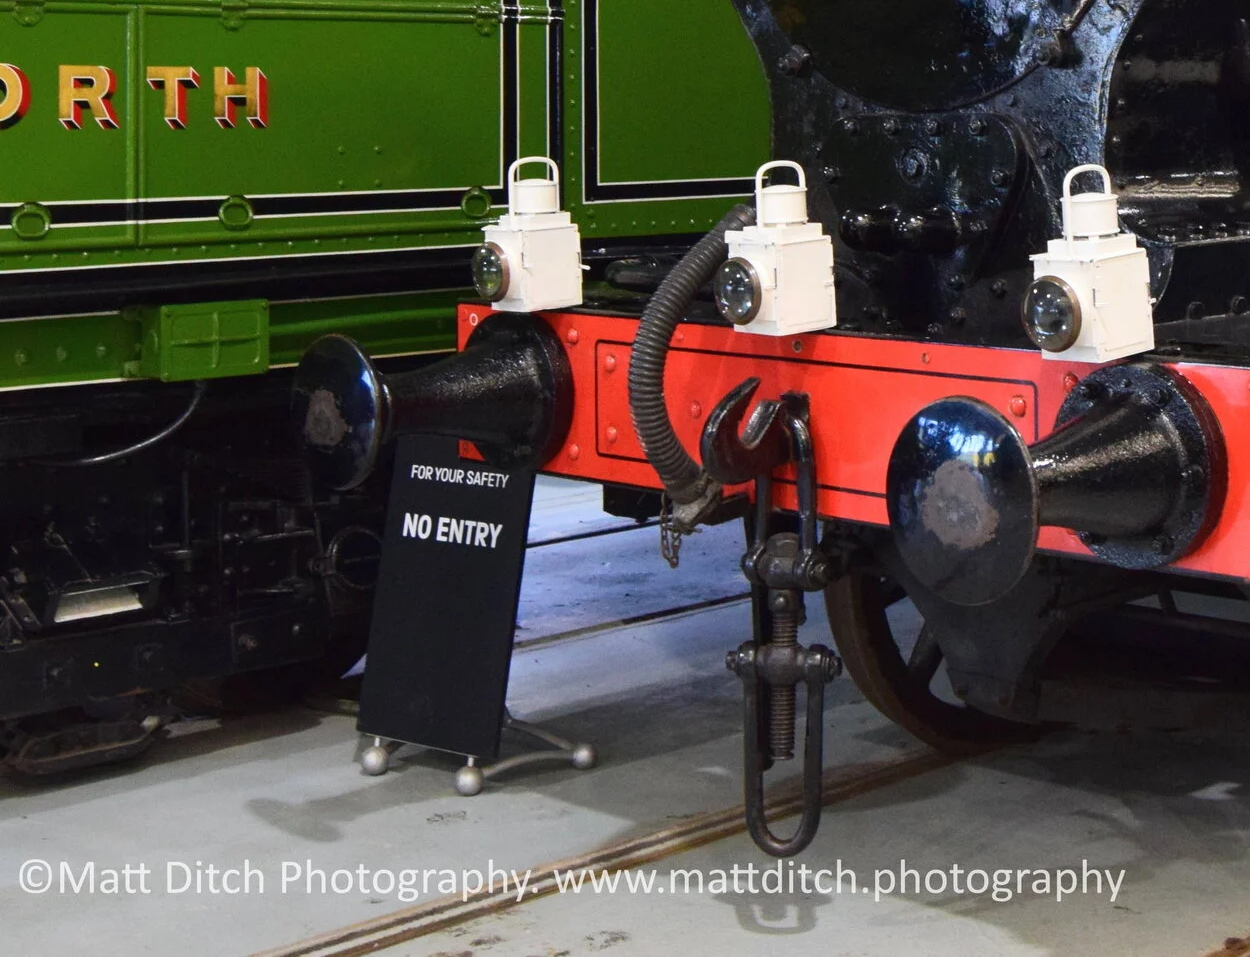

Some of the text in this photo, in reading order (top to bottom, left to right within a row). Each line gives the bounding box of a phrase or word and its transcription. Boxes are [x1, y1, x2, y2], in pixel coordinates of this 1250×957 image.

[410, 464, 509, 488] FOR YOUR SAFETY
[402, 512, 503, 548] NO ENTRY
